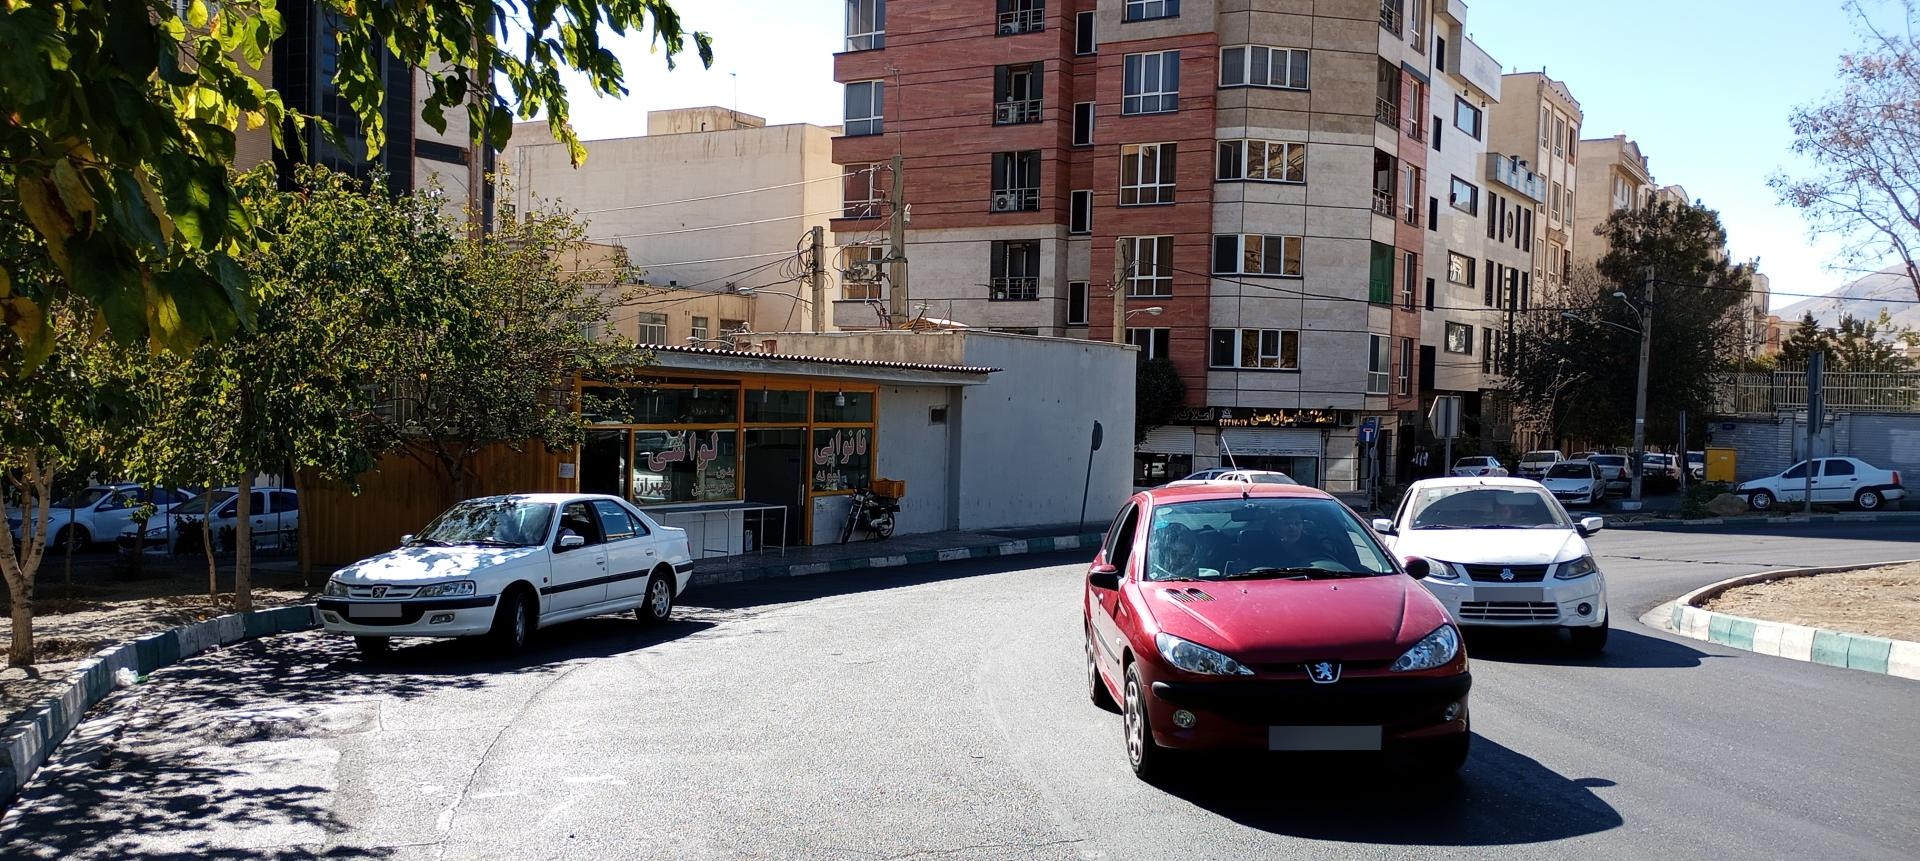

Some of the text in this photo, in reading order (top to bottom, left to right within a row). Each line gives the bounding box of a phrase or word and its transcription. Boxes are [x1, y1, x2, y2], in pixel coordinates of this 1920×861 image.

[1177, 407, 1215, 421] املاک
[1302, 409, 1336, 423] املاک
[648, 430, 719, 472] لواشی
[814, 429, 867, 465] نانوایی
[816, 469, 841, 483] نمونه
[634, 476, 672, 495] شهران
